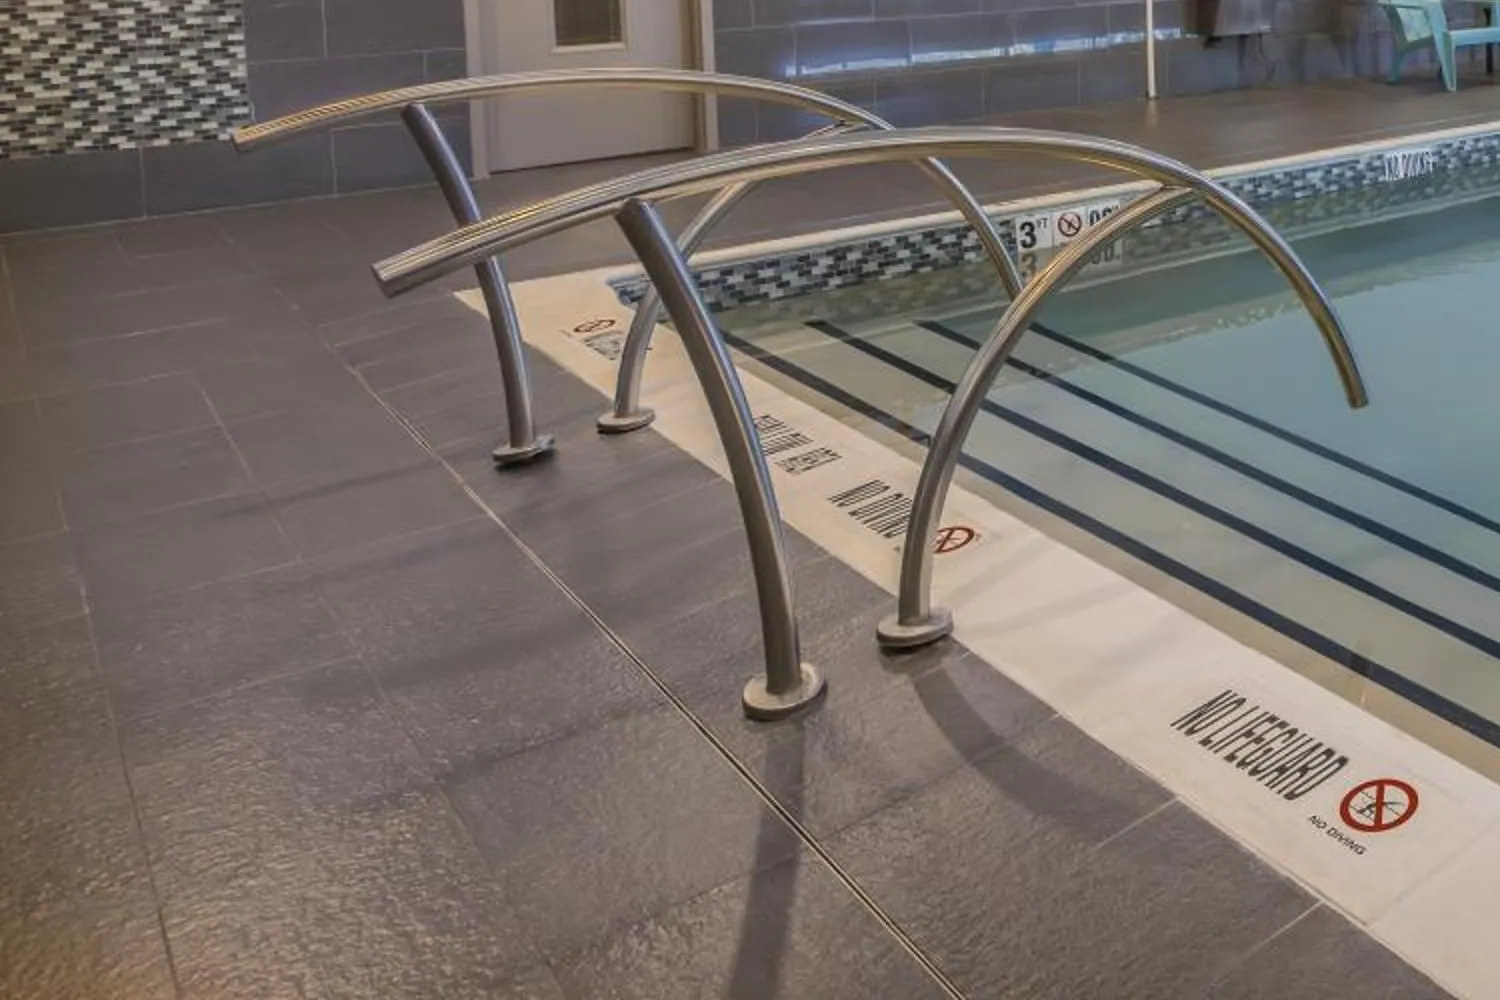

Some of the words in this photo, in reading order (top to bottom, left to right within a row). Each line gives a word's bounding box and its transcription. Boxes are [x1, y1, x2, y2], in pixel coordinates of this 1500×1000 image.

[1019, 221, 1037, 249] 3
[826, 479, 891, 507] NO
[1169, 689, 1246, 736] NO
[1198, 705, 1349, 801] LIFEGUARD
[1308, 815, 1328, 830] NO
[1326, 828, 1367, 855] DIVING
